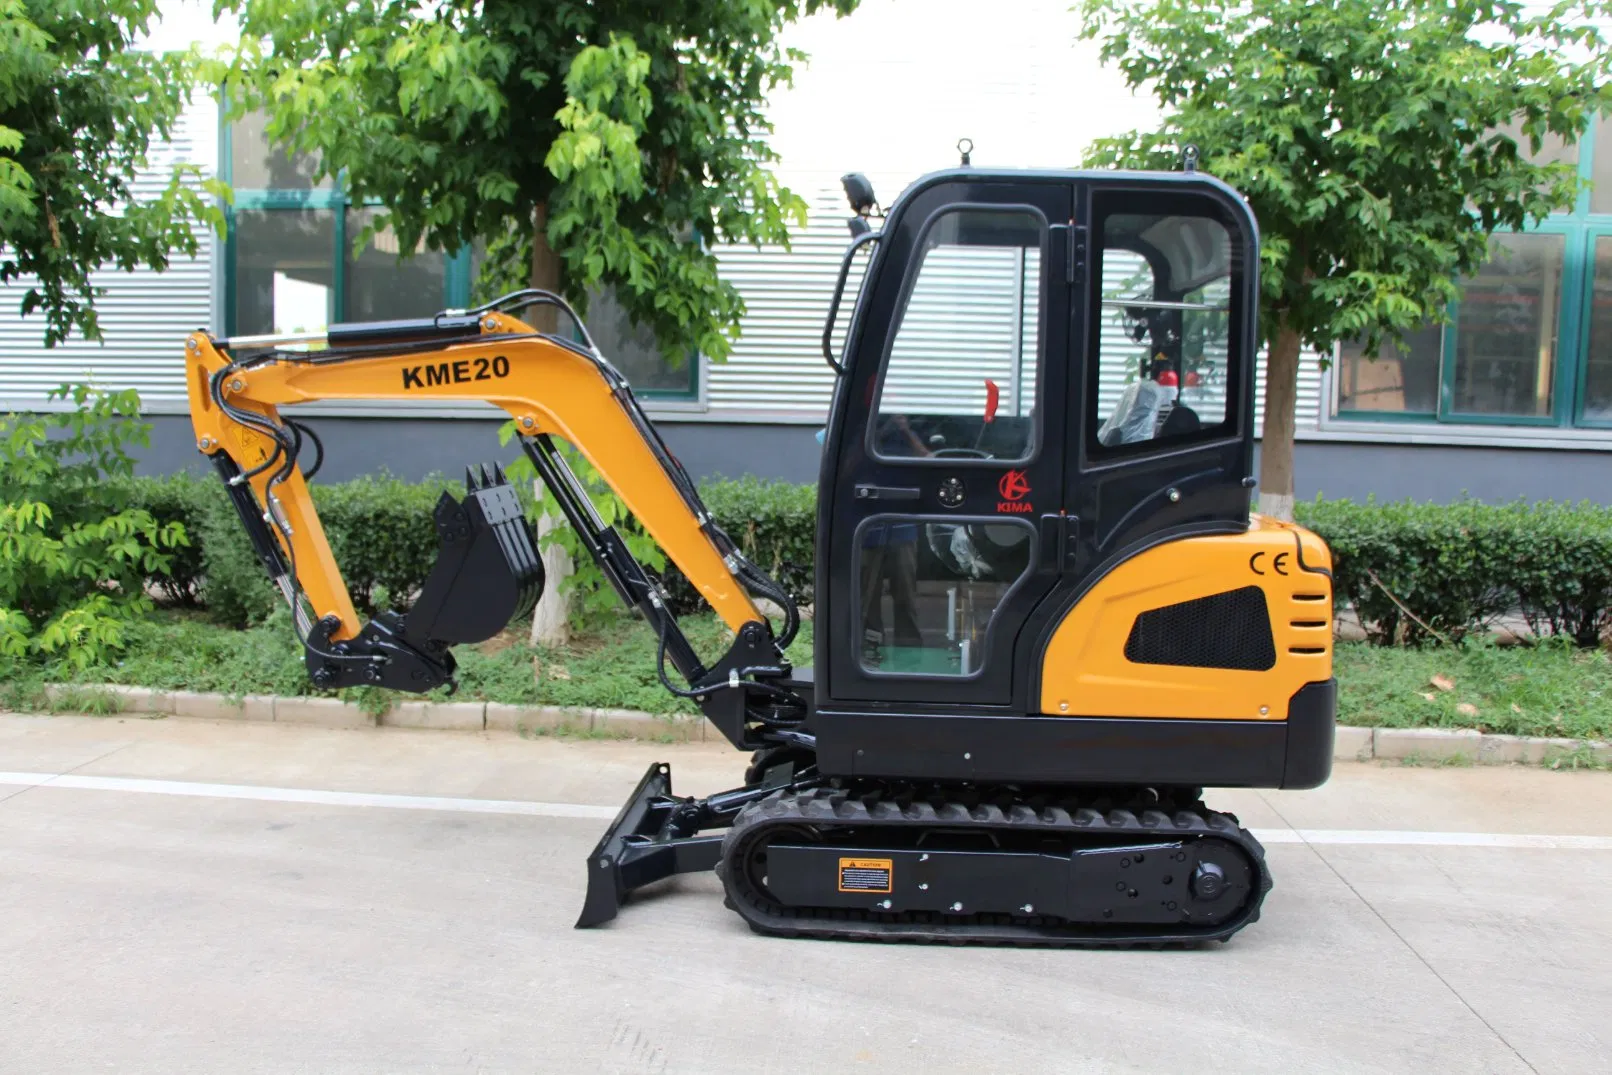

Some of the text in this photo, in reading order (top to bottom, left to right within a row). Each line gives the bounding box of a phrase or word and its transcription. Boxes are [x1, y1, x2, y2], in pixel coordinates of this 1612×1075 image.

[402, 356, 510, 389] KME20
[997, 502, 1033, 512] KIMA
[1249, 551, 1289, 576] CE
